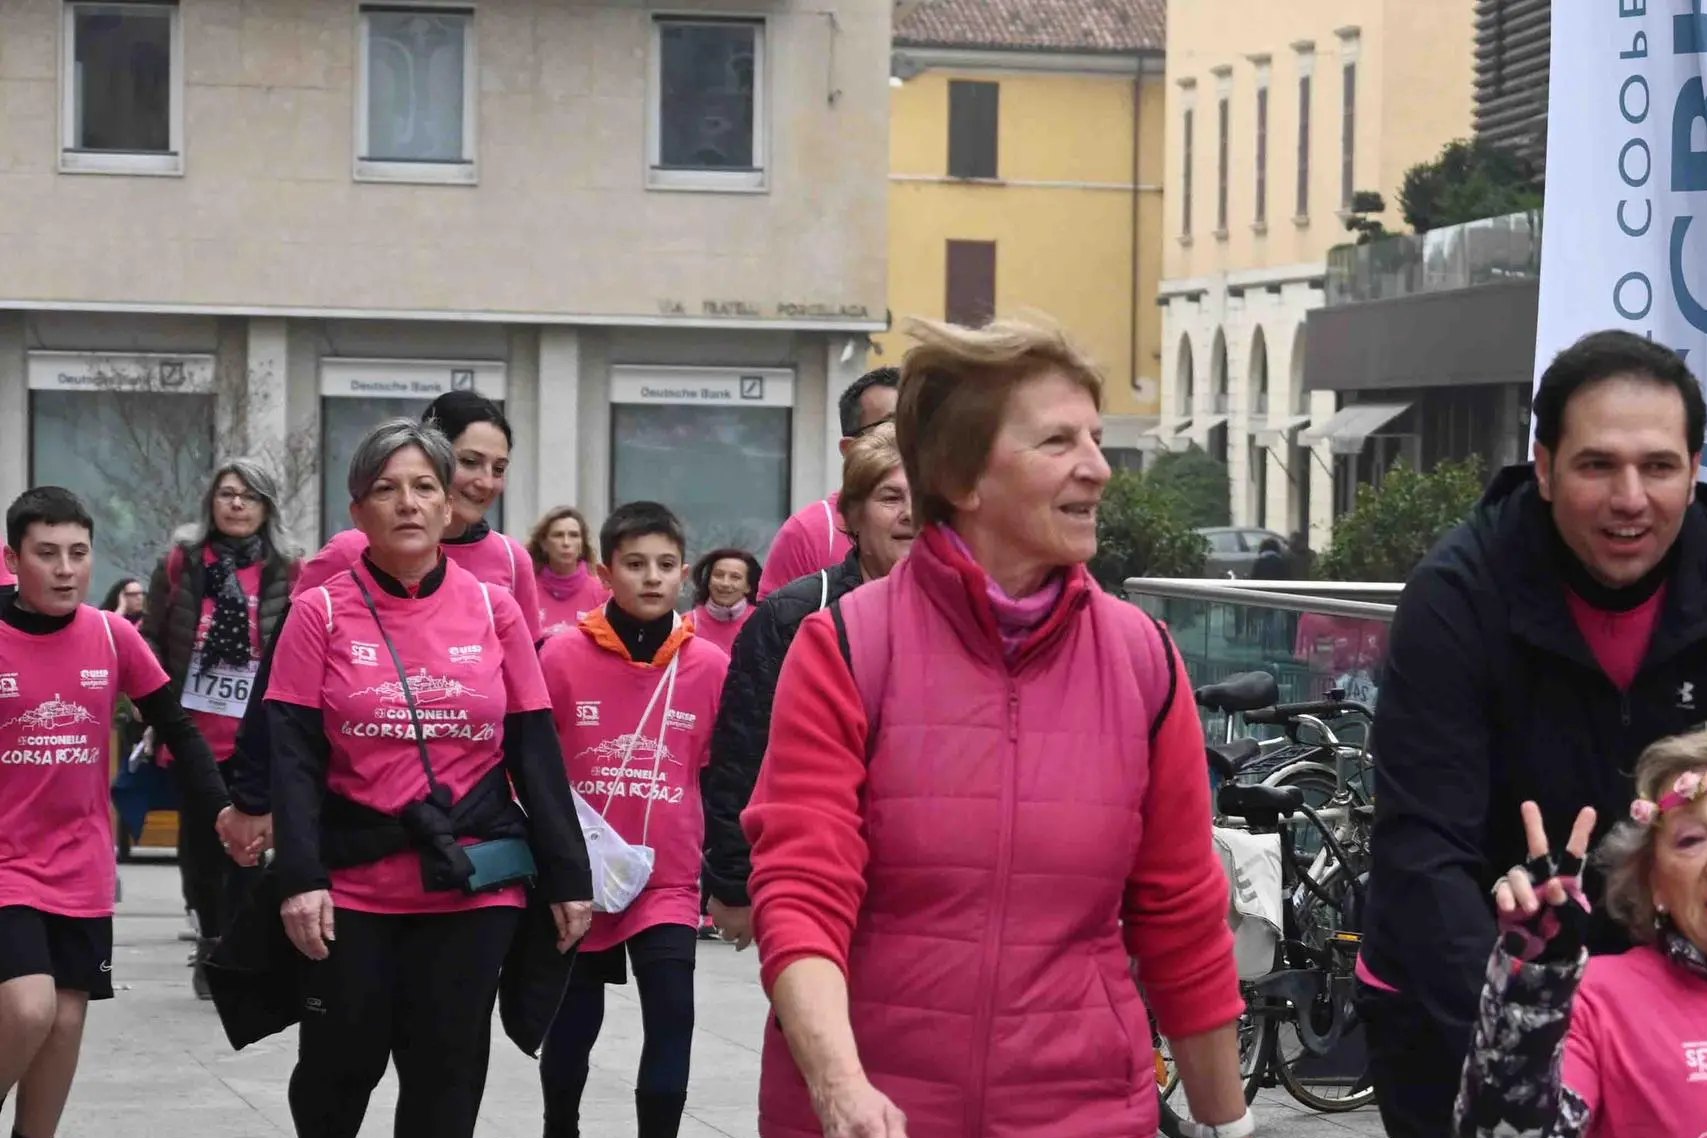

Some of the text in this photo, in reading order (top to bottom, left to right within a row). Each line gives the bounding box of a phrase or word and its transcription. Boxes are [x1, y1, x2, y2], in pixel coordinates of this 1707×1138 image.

[351, 380, 408, 392] Deutsche
[641, 386, 731, 400] Deutsche Bank
[192, 672, 249, 700] 1756
[353, 723, 416, 740] CORSA
[28, 735, 87, 746] COTONELLA
[2, 750, 52, 764] CORSA
